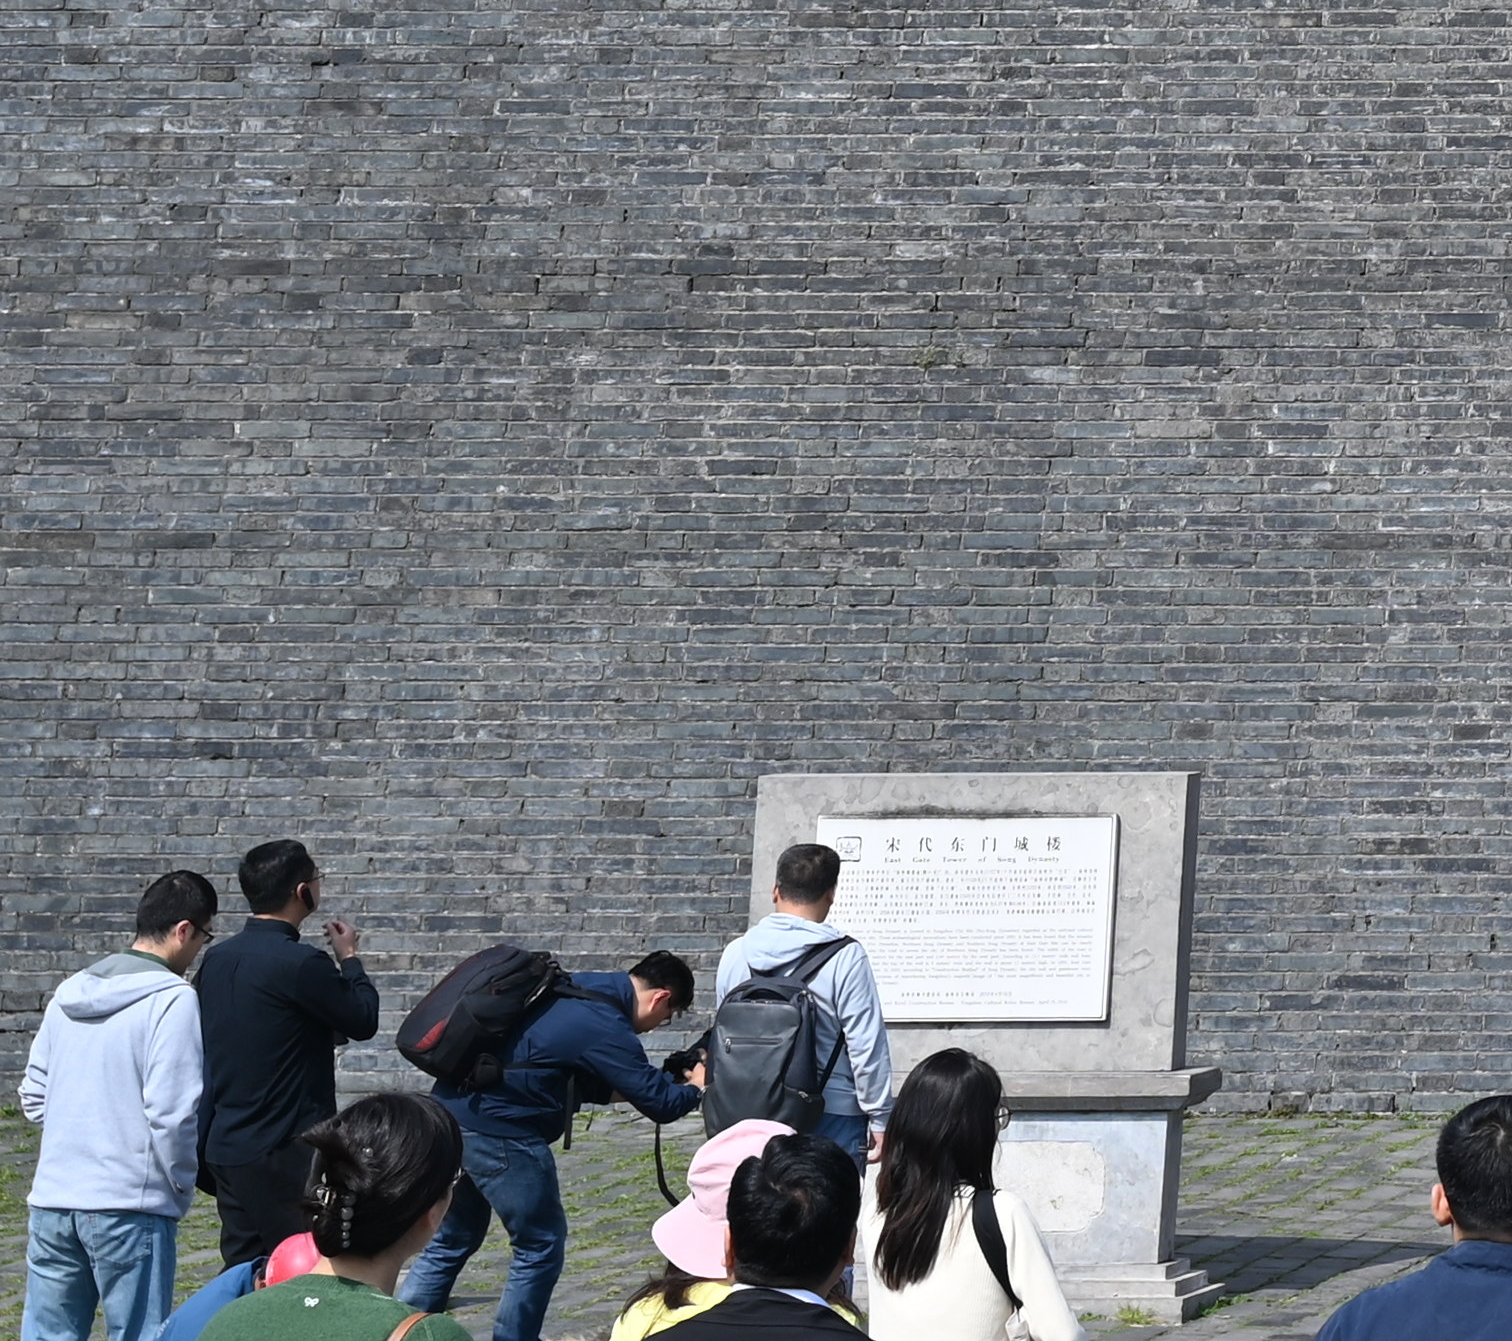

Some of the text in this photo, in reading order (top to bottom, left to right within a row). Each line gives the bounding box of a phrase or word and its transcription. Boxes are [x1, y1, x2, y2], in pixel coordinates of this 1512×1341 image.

[886, 836, 1062, 853] 宋代东门城楼
